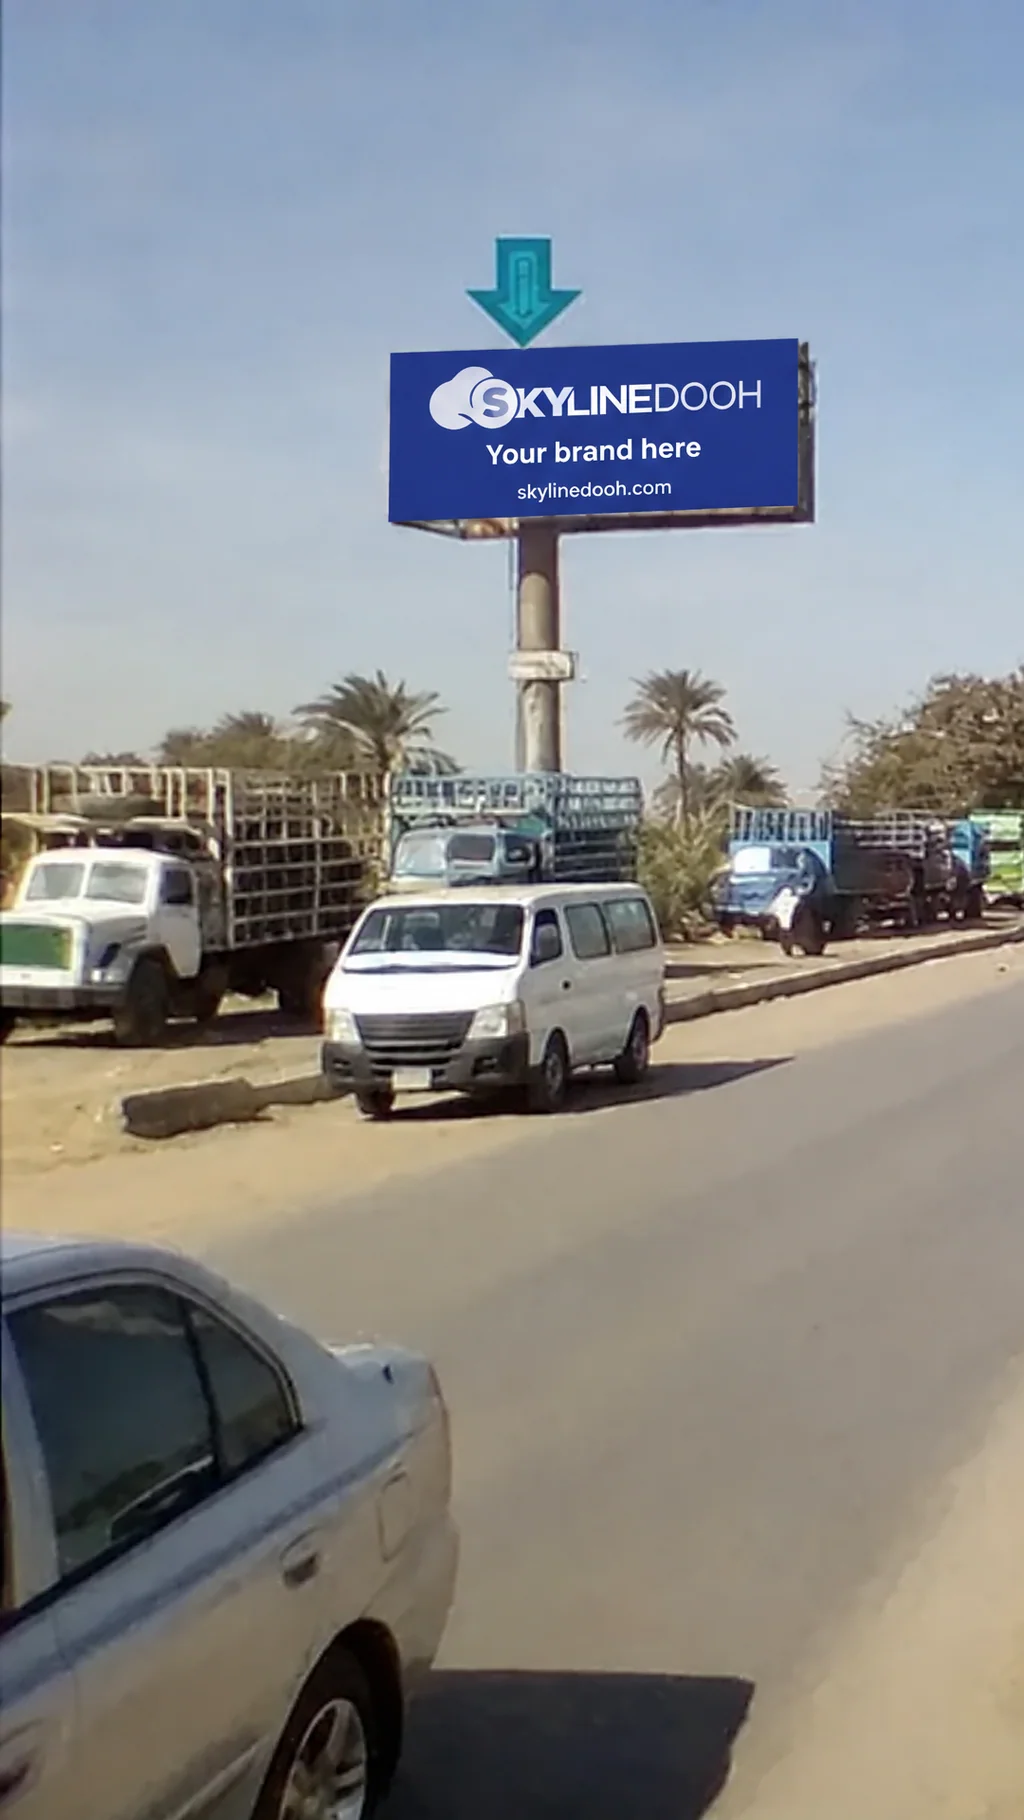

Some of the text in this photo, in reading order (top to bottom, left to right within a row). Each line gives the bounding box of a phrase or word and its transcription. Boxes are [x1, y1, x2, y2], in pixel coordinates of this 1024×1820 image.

[482, 380, 762, 419] SKYLINEDOOH
[486, 438, 701, 465] Your brand here
[518, 481, 671, 502] skylinedooh.com
